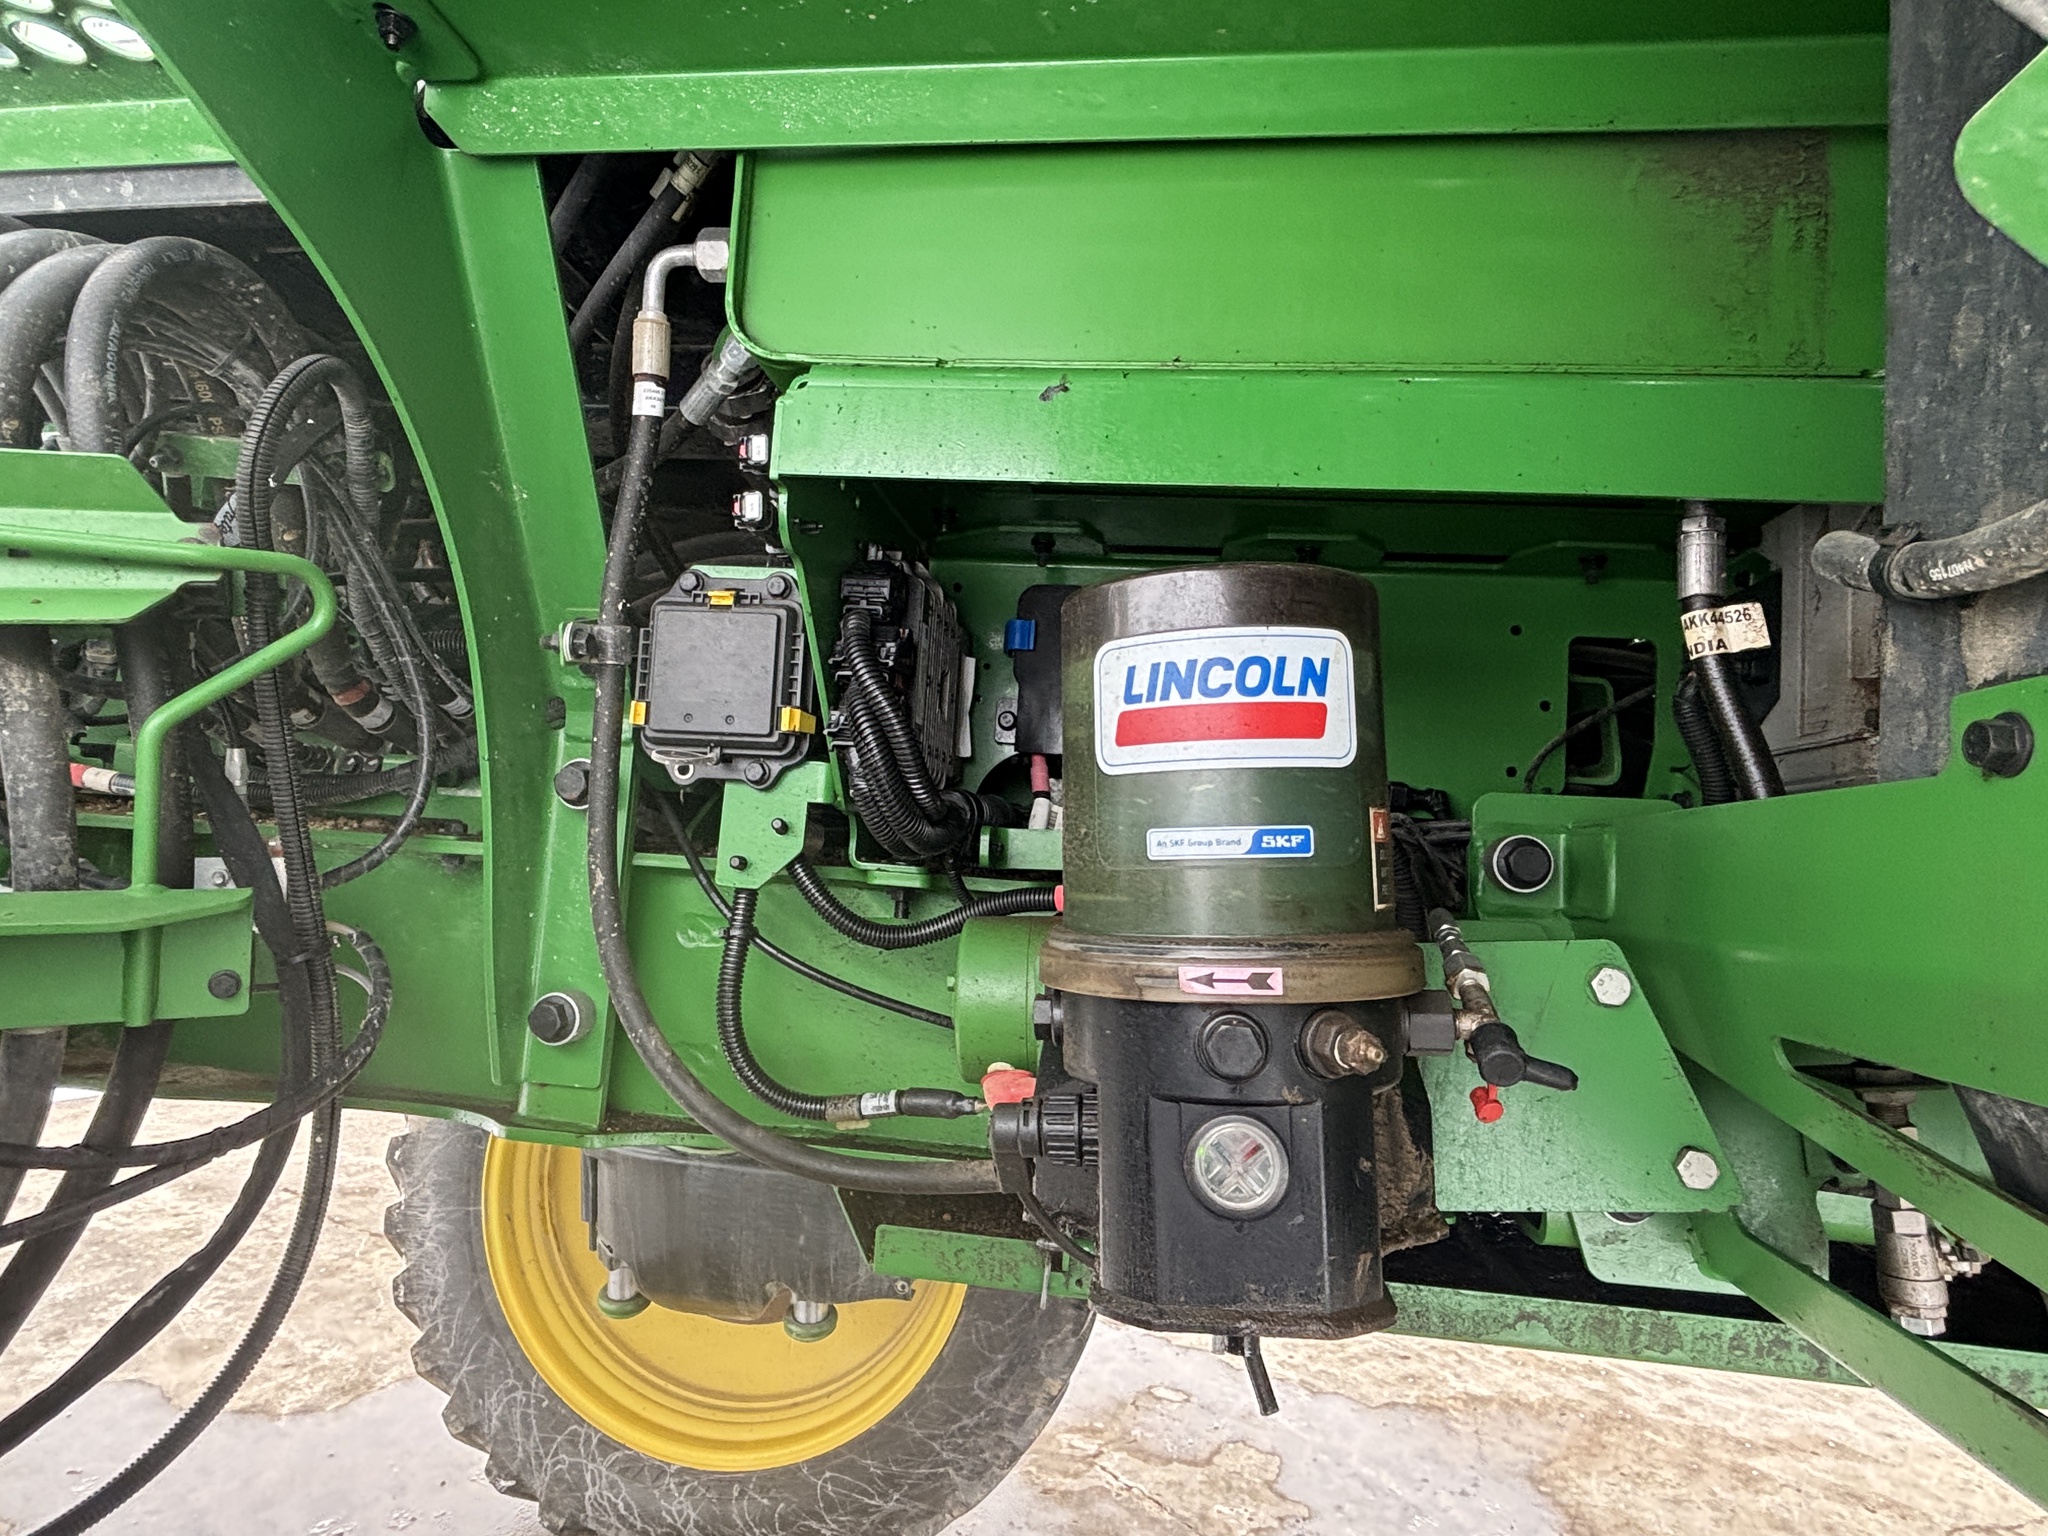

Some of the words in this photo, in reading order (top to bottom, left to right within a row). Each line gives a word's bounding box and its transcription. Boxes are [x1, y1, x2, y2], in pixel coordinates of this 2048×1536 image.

[1123, 655, 1331, 705] LINCOLN
[1156, 839, 1168, 848] An
[1169, 839, 1185, 848] SKF
[1187, 838, 1213, 848] Group
[1216, 837, 1242, 847] Brand
[1261, 834, 1305, 848] SKF
